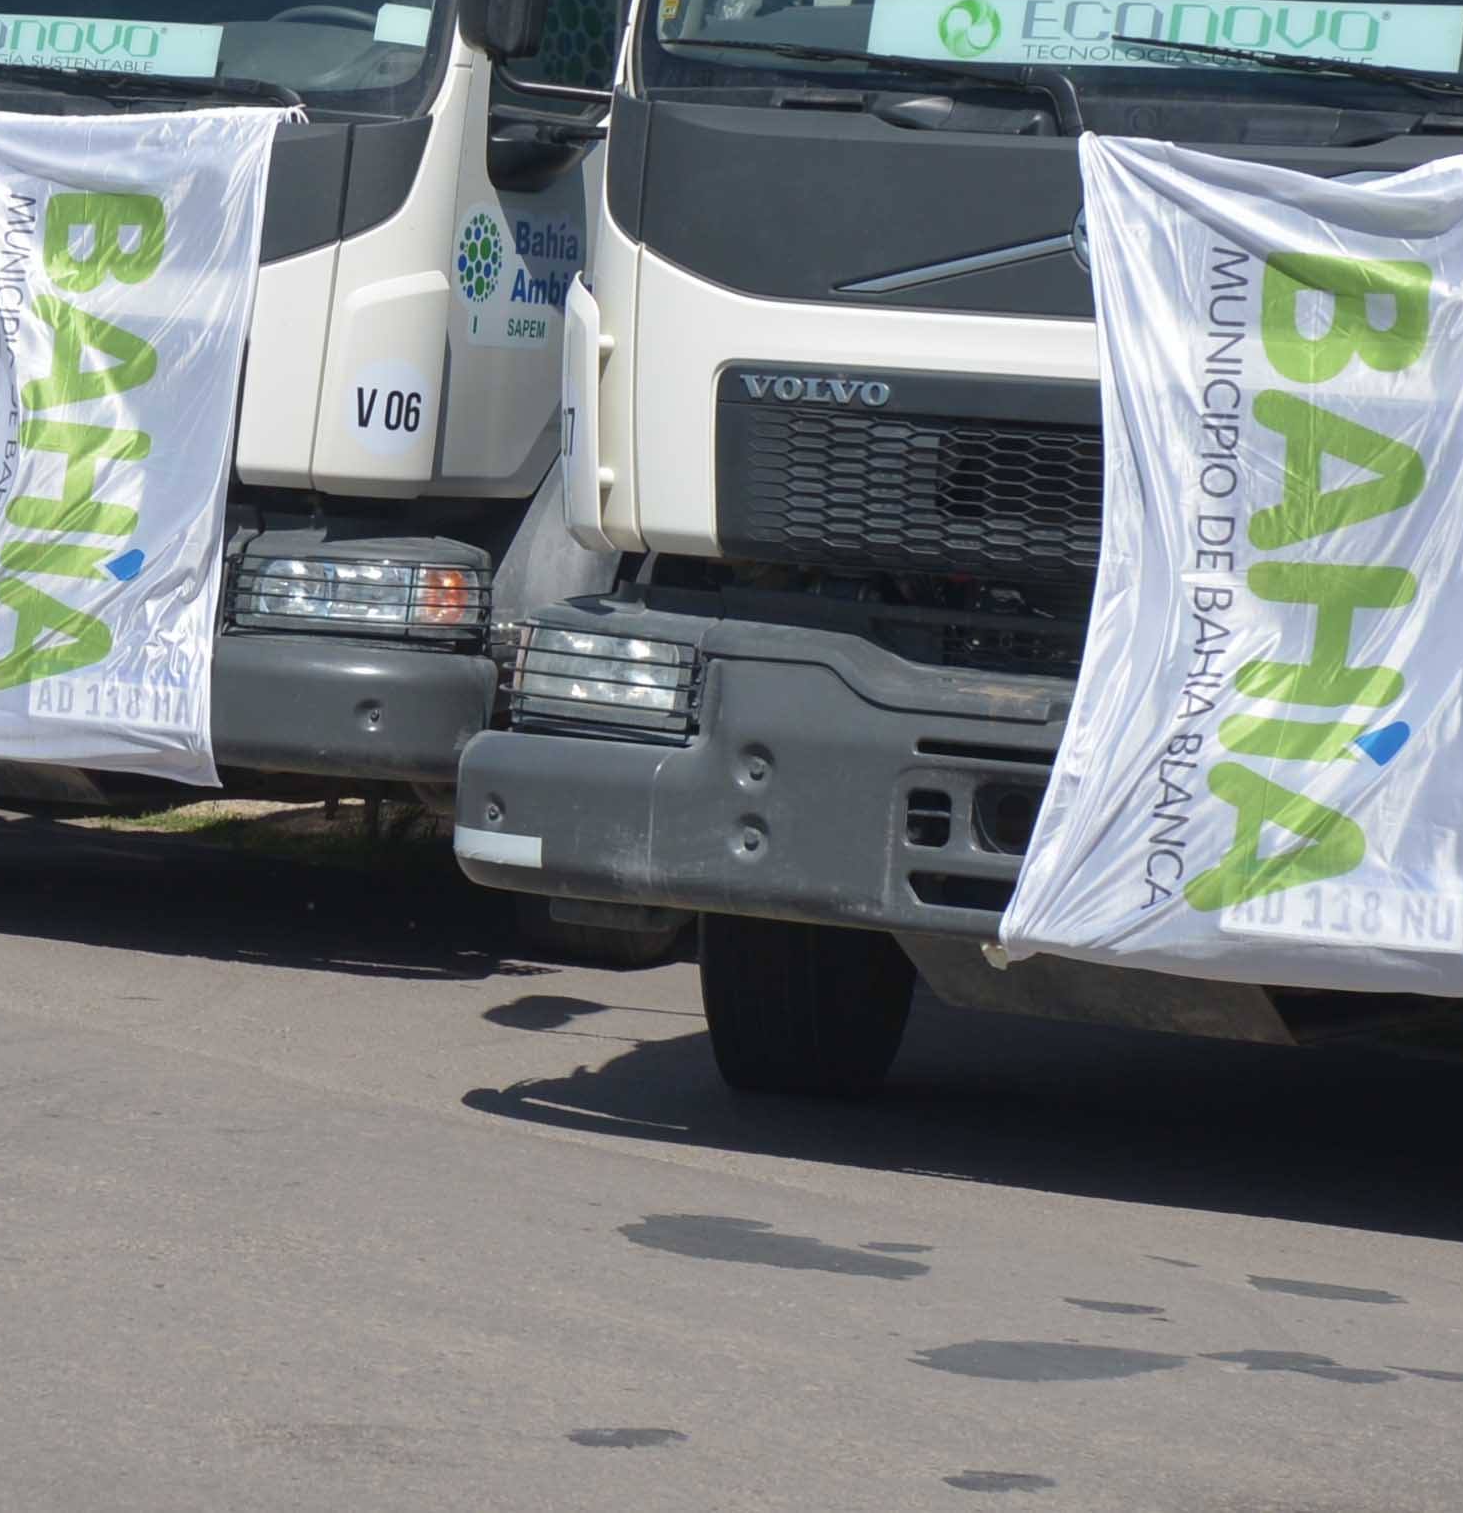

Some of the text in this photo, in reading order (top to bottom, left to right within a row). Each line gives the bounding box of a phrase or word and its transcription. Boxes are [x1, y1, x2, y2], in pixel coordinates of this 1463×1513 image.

[1021, 0, 1380, 52] ECONOVO
[515, 217, 578, 261] Bahía
[507, 318, 546, 339] SAPEM
[355, 387, 422, 434] V 06
[740, 373, 891, 407] VOLVO
[1140, 245, 1250, 910] MUNICIPIO DE BAHIA BLANCA
[1302, 884, 1381, 934] 118
[1401, 895, 1455, 942] NU
